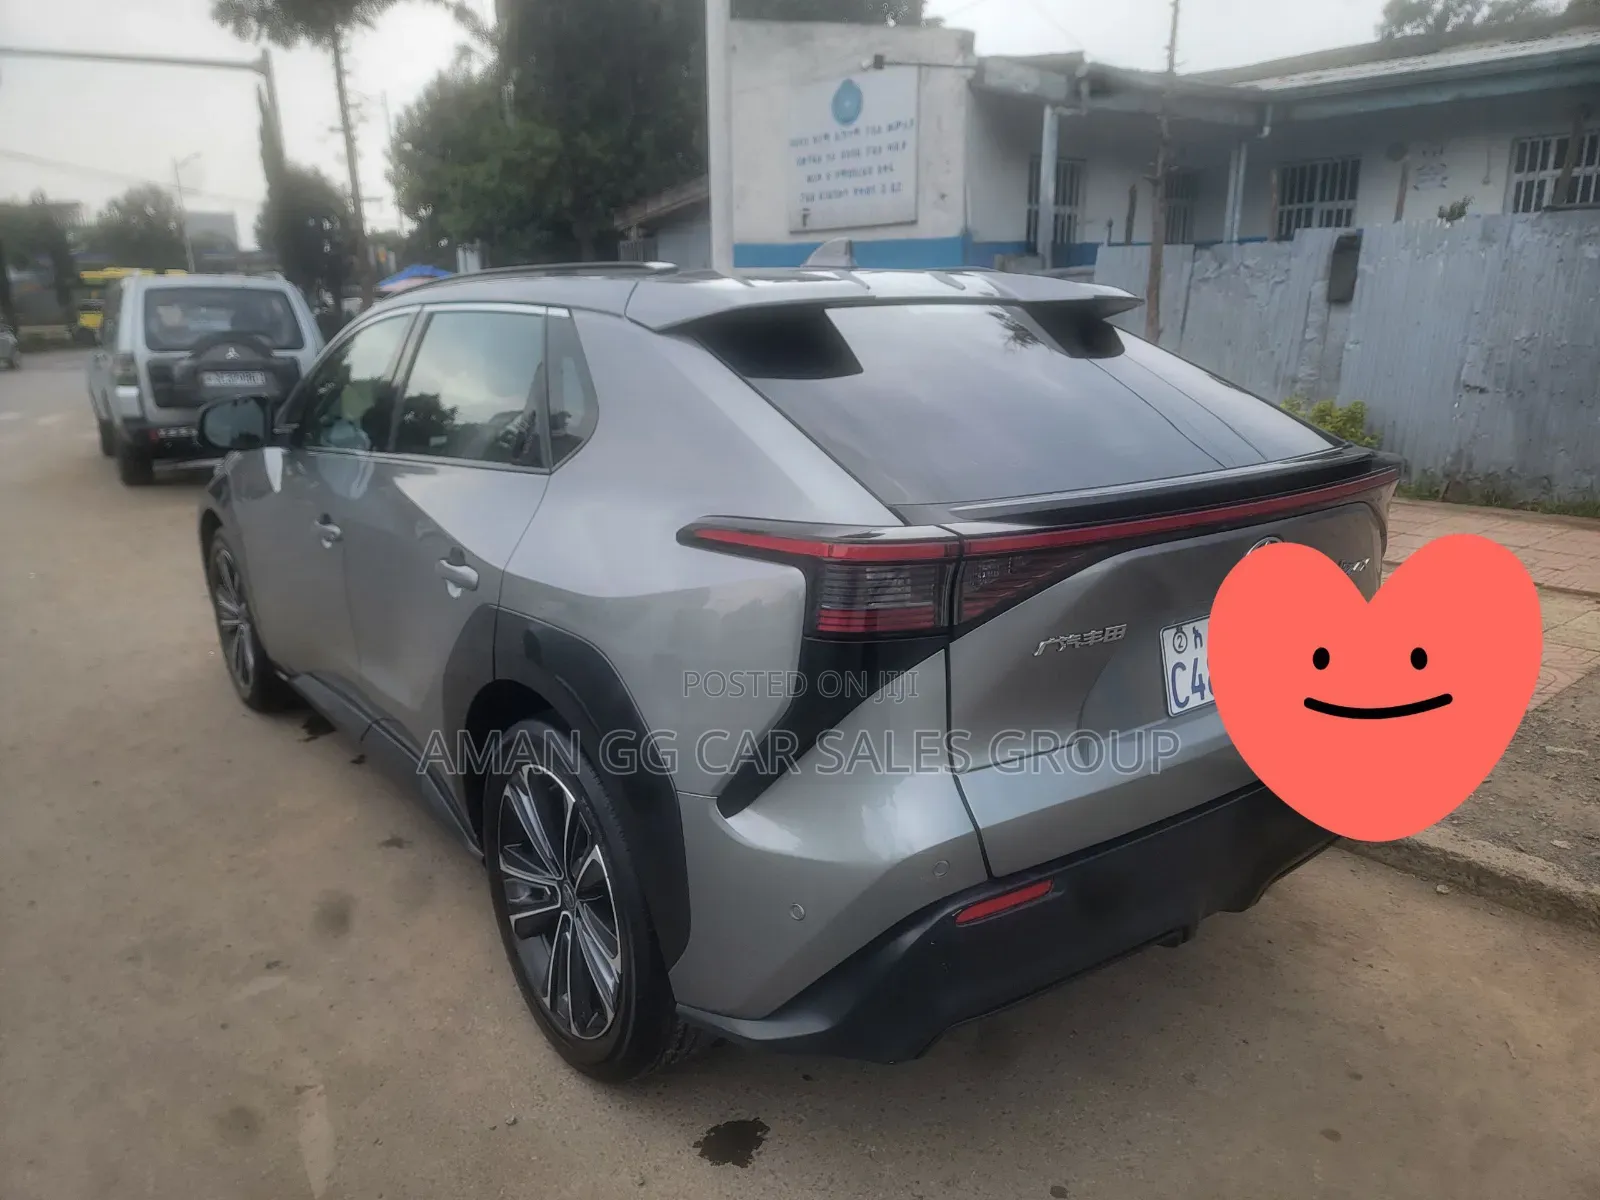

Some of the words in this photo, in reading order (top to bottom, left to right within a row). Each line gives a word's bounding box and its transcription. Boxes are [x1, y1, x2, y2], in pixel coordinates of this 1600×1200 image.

[1033, 623, 1128, 656] 广汽丰田
[1171, 657, 1214, 708] C4
